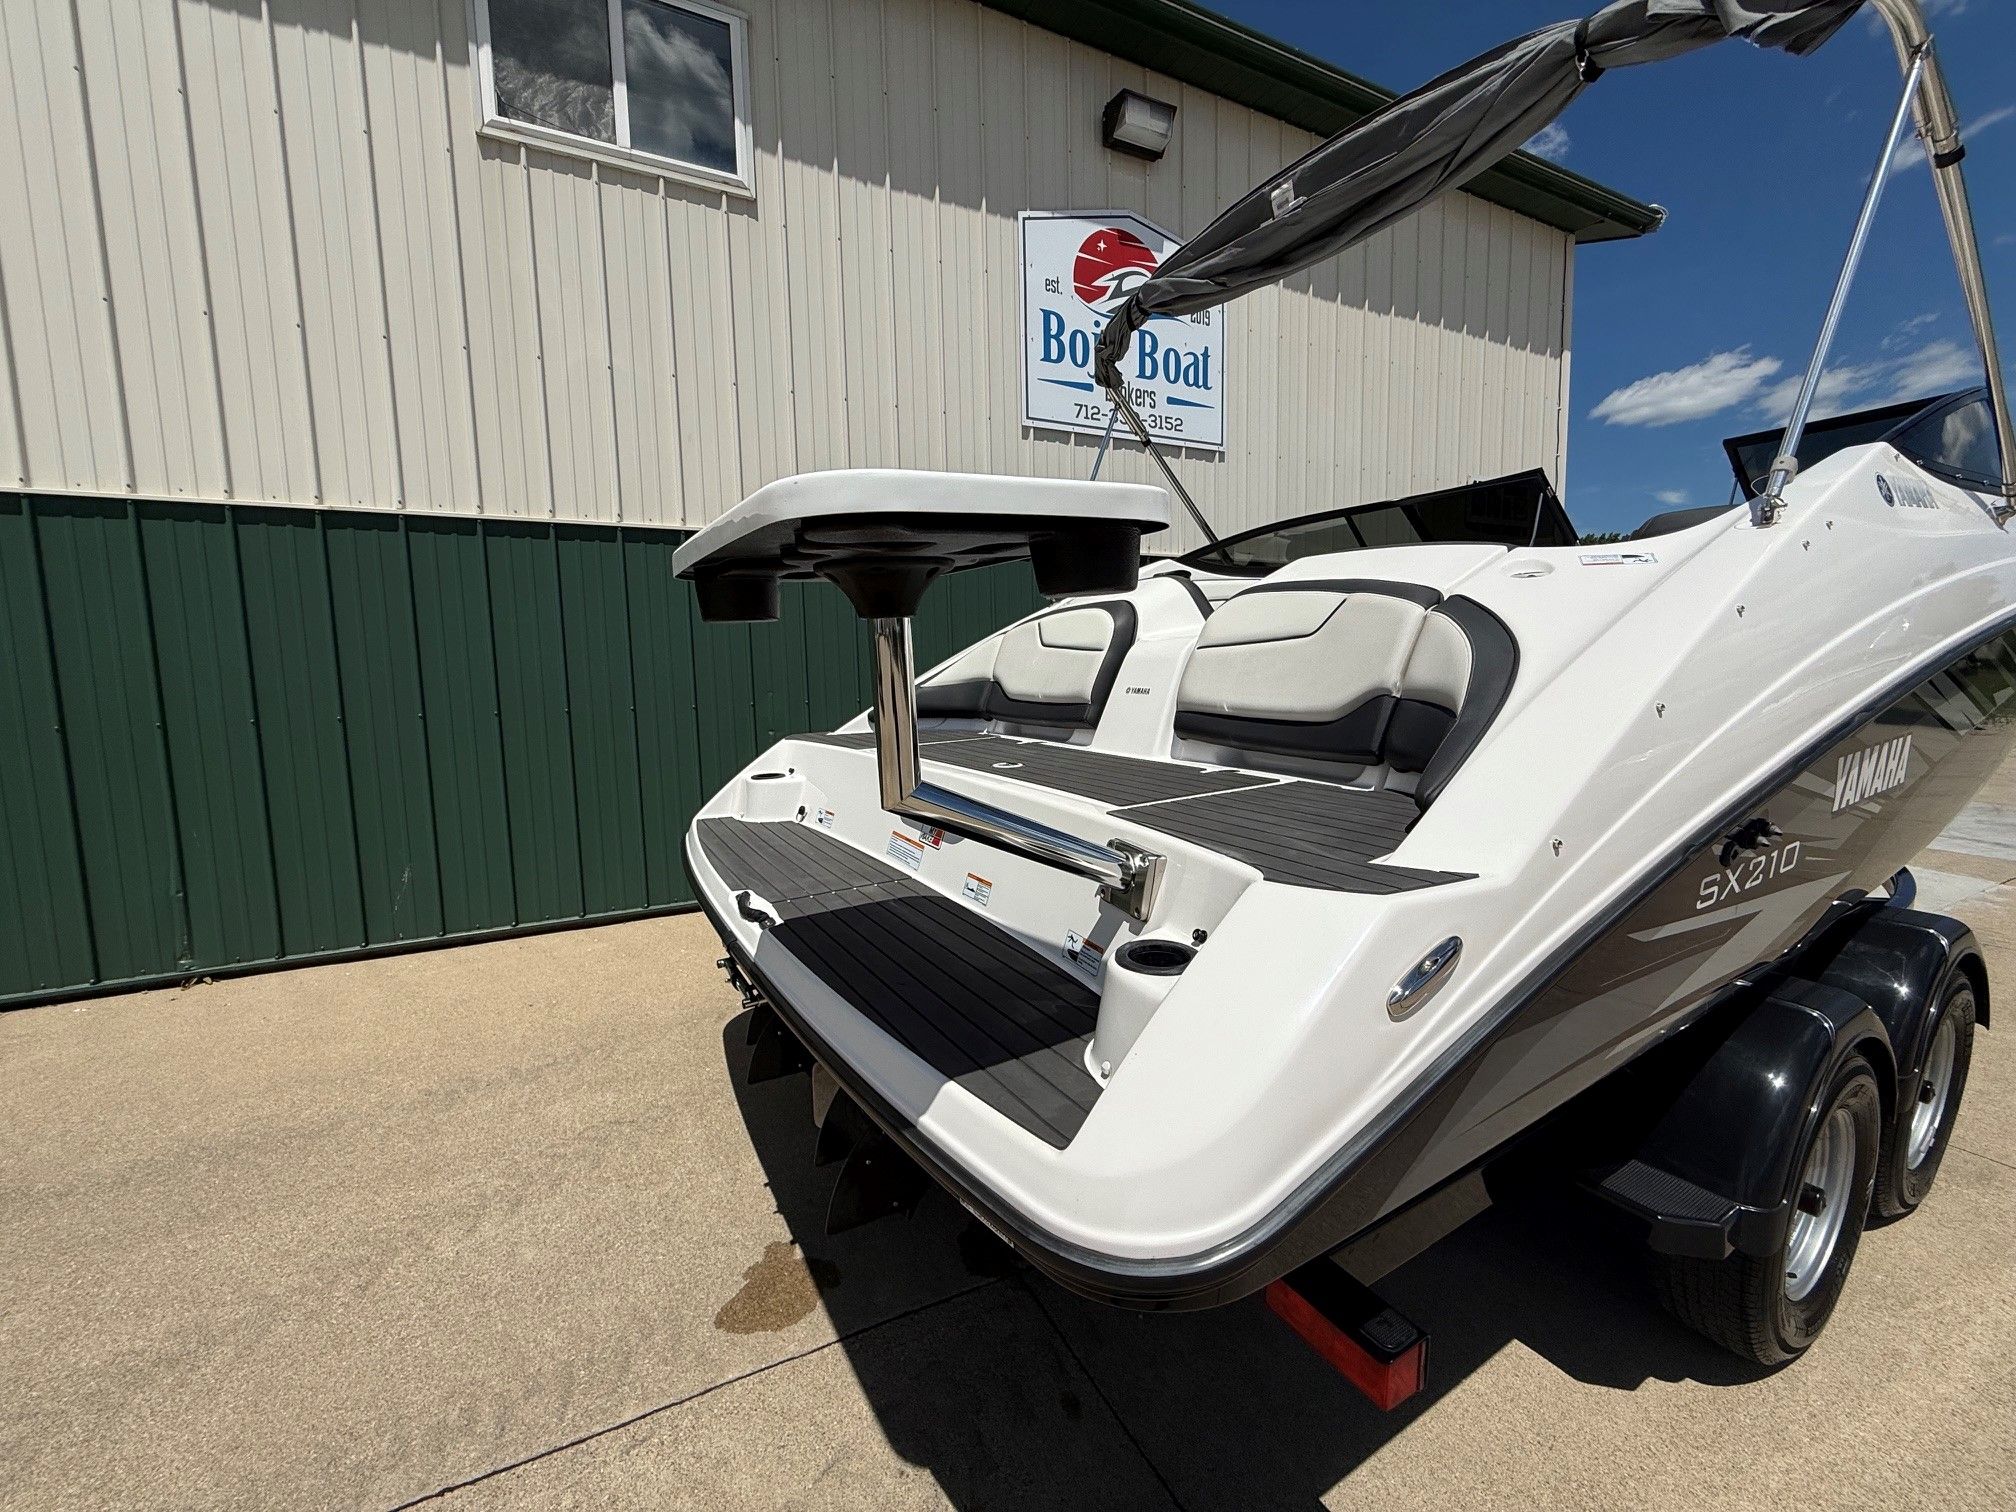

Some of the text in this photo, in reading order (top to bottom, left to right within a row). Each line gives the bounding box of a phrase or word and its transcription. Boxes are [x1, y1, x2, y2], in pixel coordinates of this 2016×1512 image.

[1044, 276, 1063, 296] est.
[1135, 328, 1213, 391] Boat
[1831, 733, 1913, 814] YAMAHA
[1696, 841, 1801, 910] SX210
